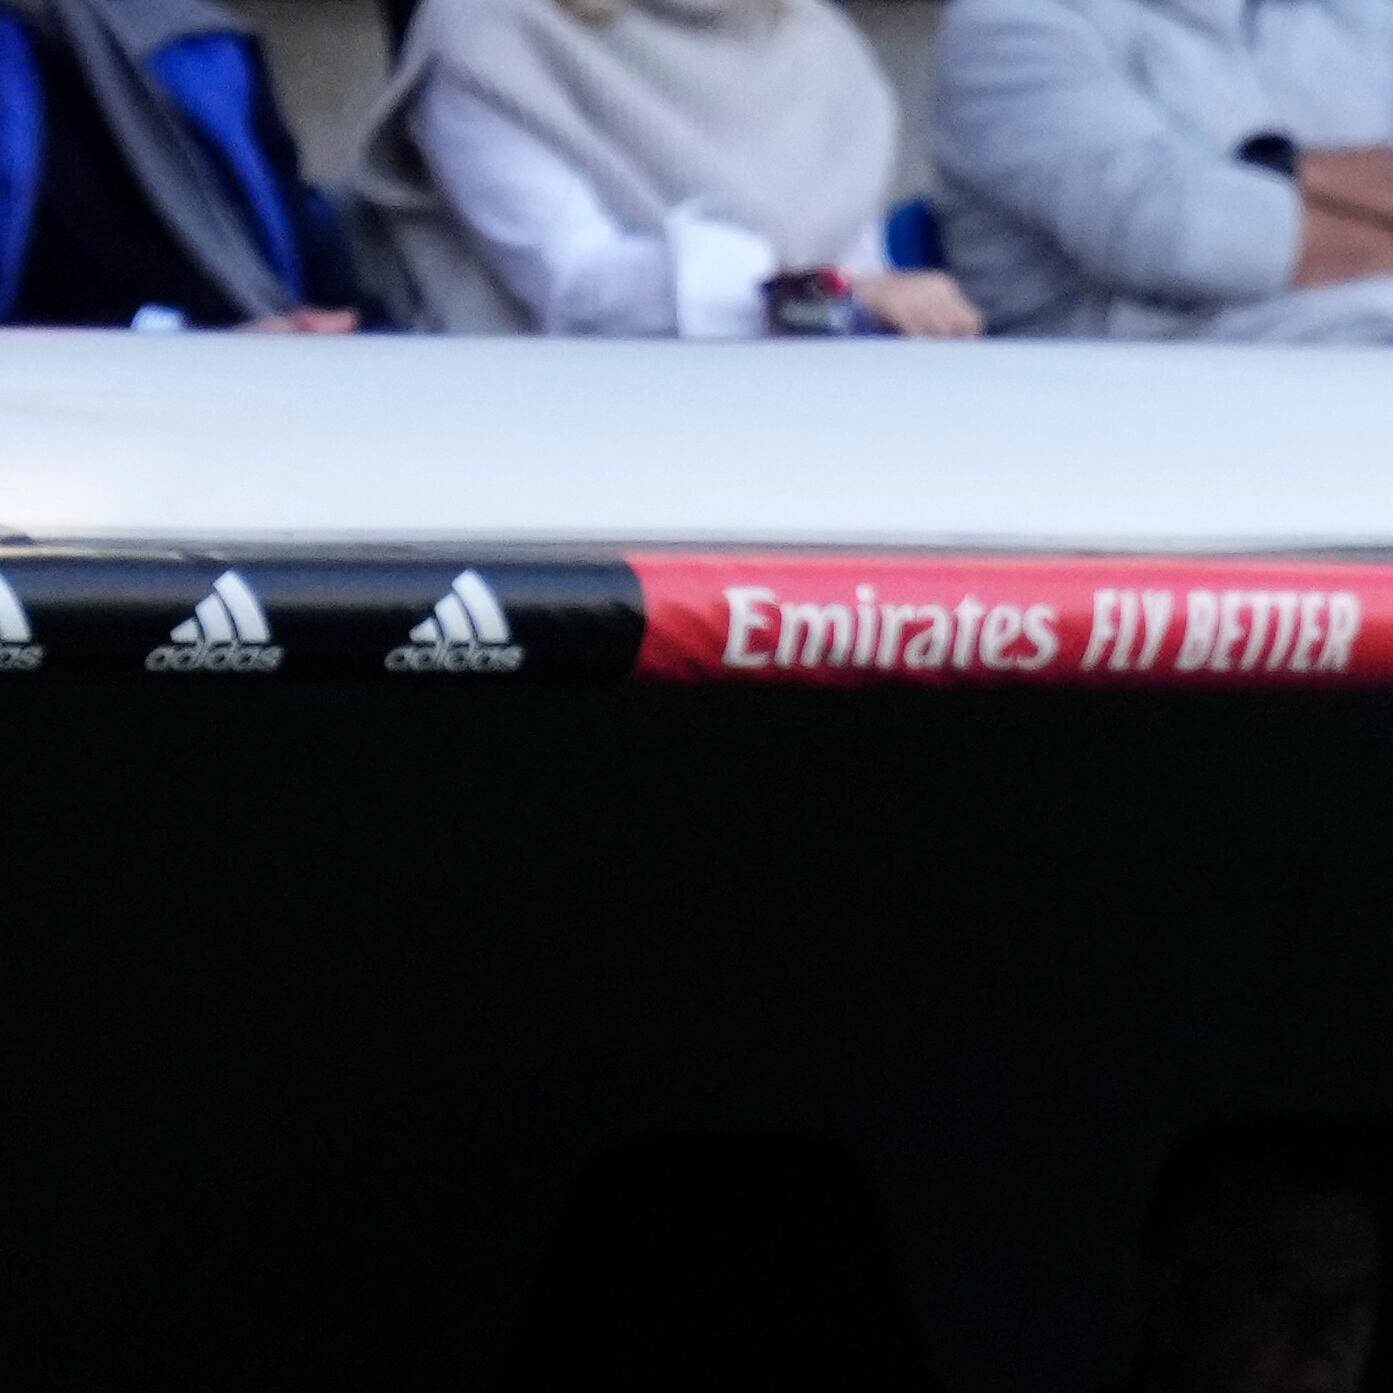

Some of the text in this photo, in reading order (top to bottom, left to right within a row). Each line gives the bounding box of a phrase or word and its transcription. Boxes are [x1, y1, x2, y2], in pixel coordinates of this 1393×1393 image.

[722, 582, 1363, 673] Emirates FLY BETTER
[143, 642, 285, 672] adidas
[383, 642, 525, 672] adidas
